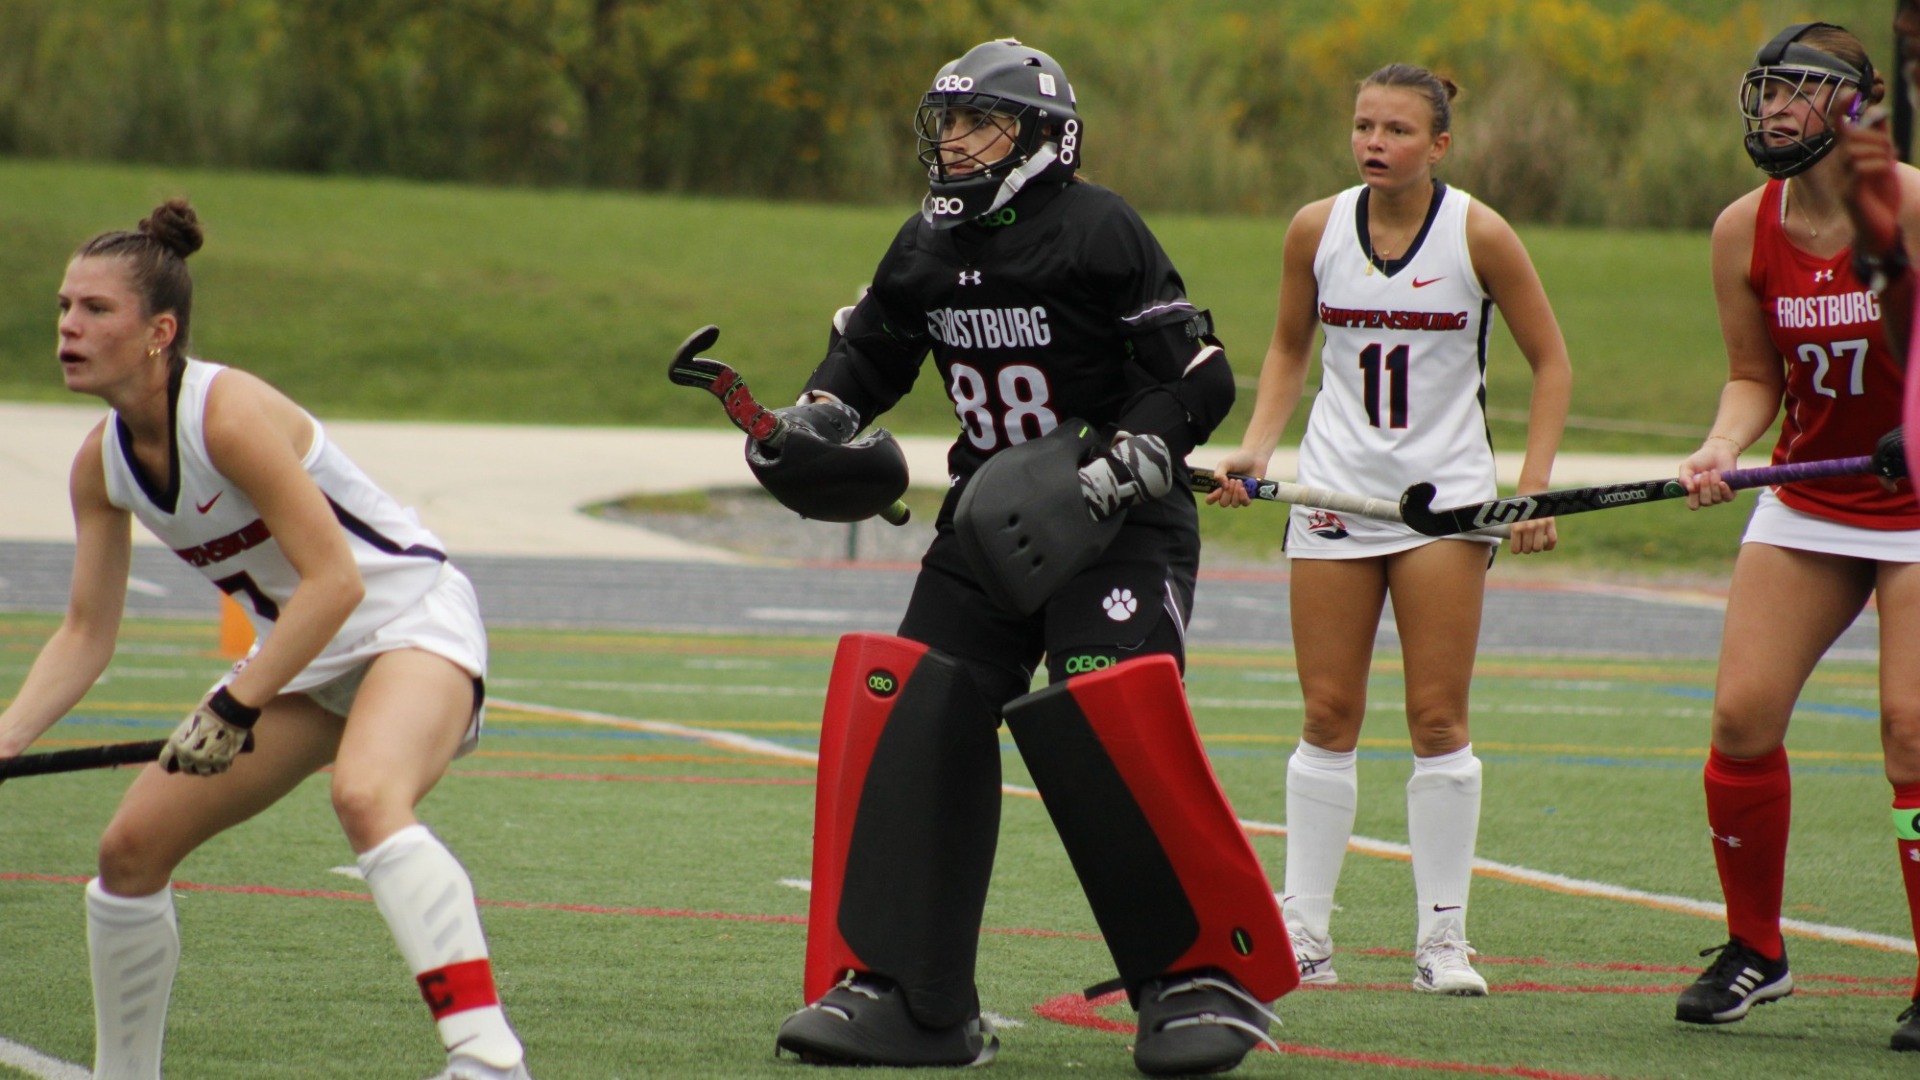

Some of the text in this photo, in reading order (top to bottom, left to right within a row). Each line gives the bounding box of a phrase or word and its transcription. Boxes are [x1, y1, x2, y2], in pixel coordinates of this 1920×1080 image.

[936, 75, 973, 91] OBO
[1060, 119, 1078, 164] OBO
[1320, 302, 1468, 331] SHIPPENSBURG
[1777, 290, 1881, 328] FROSTBURG
[1359, 342, 1410, 429] 11
[1797, 338, 1869, 399] 27
[950, 362, 1059, 450] 88
[212, 570, 280, 622] 7
[868, 675, 893, 692] OBO
[1065, 655, 1110, 674] OBO
